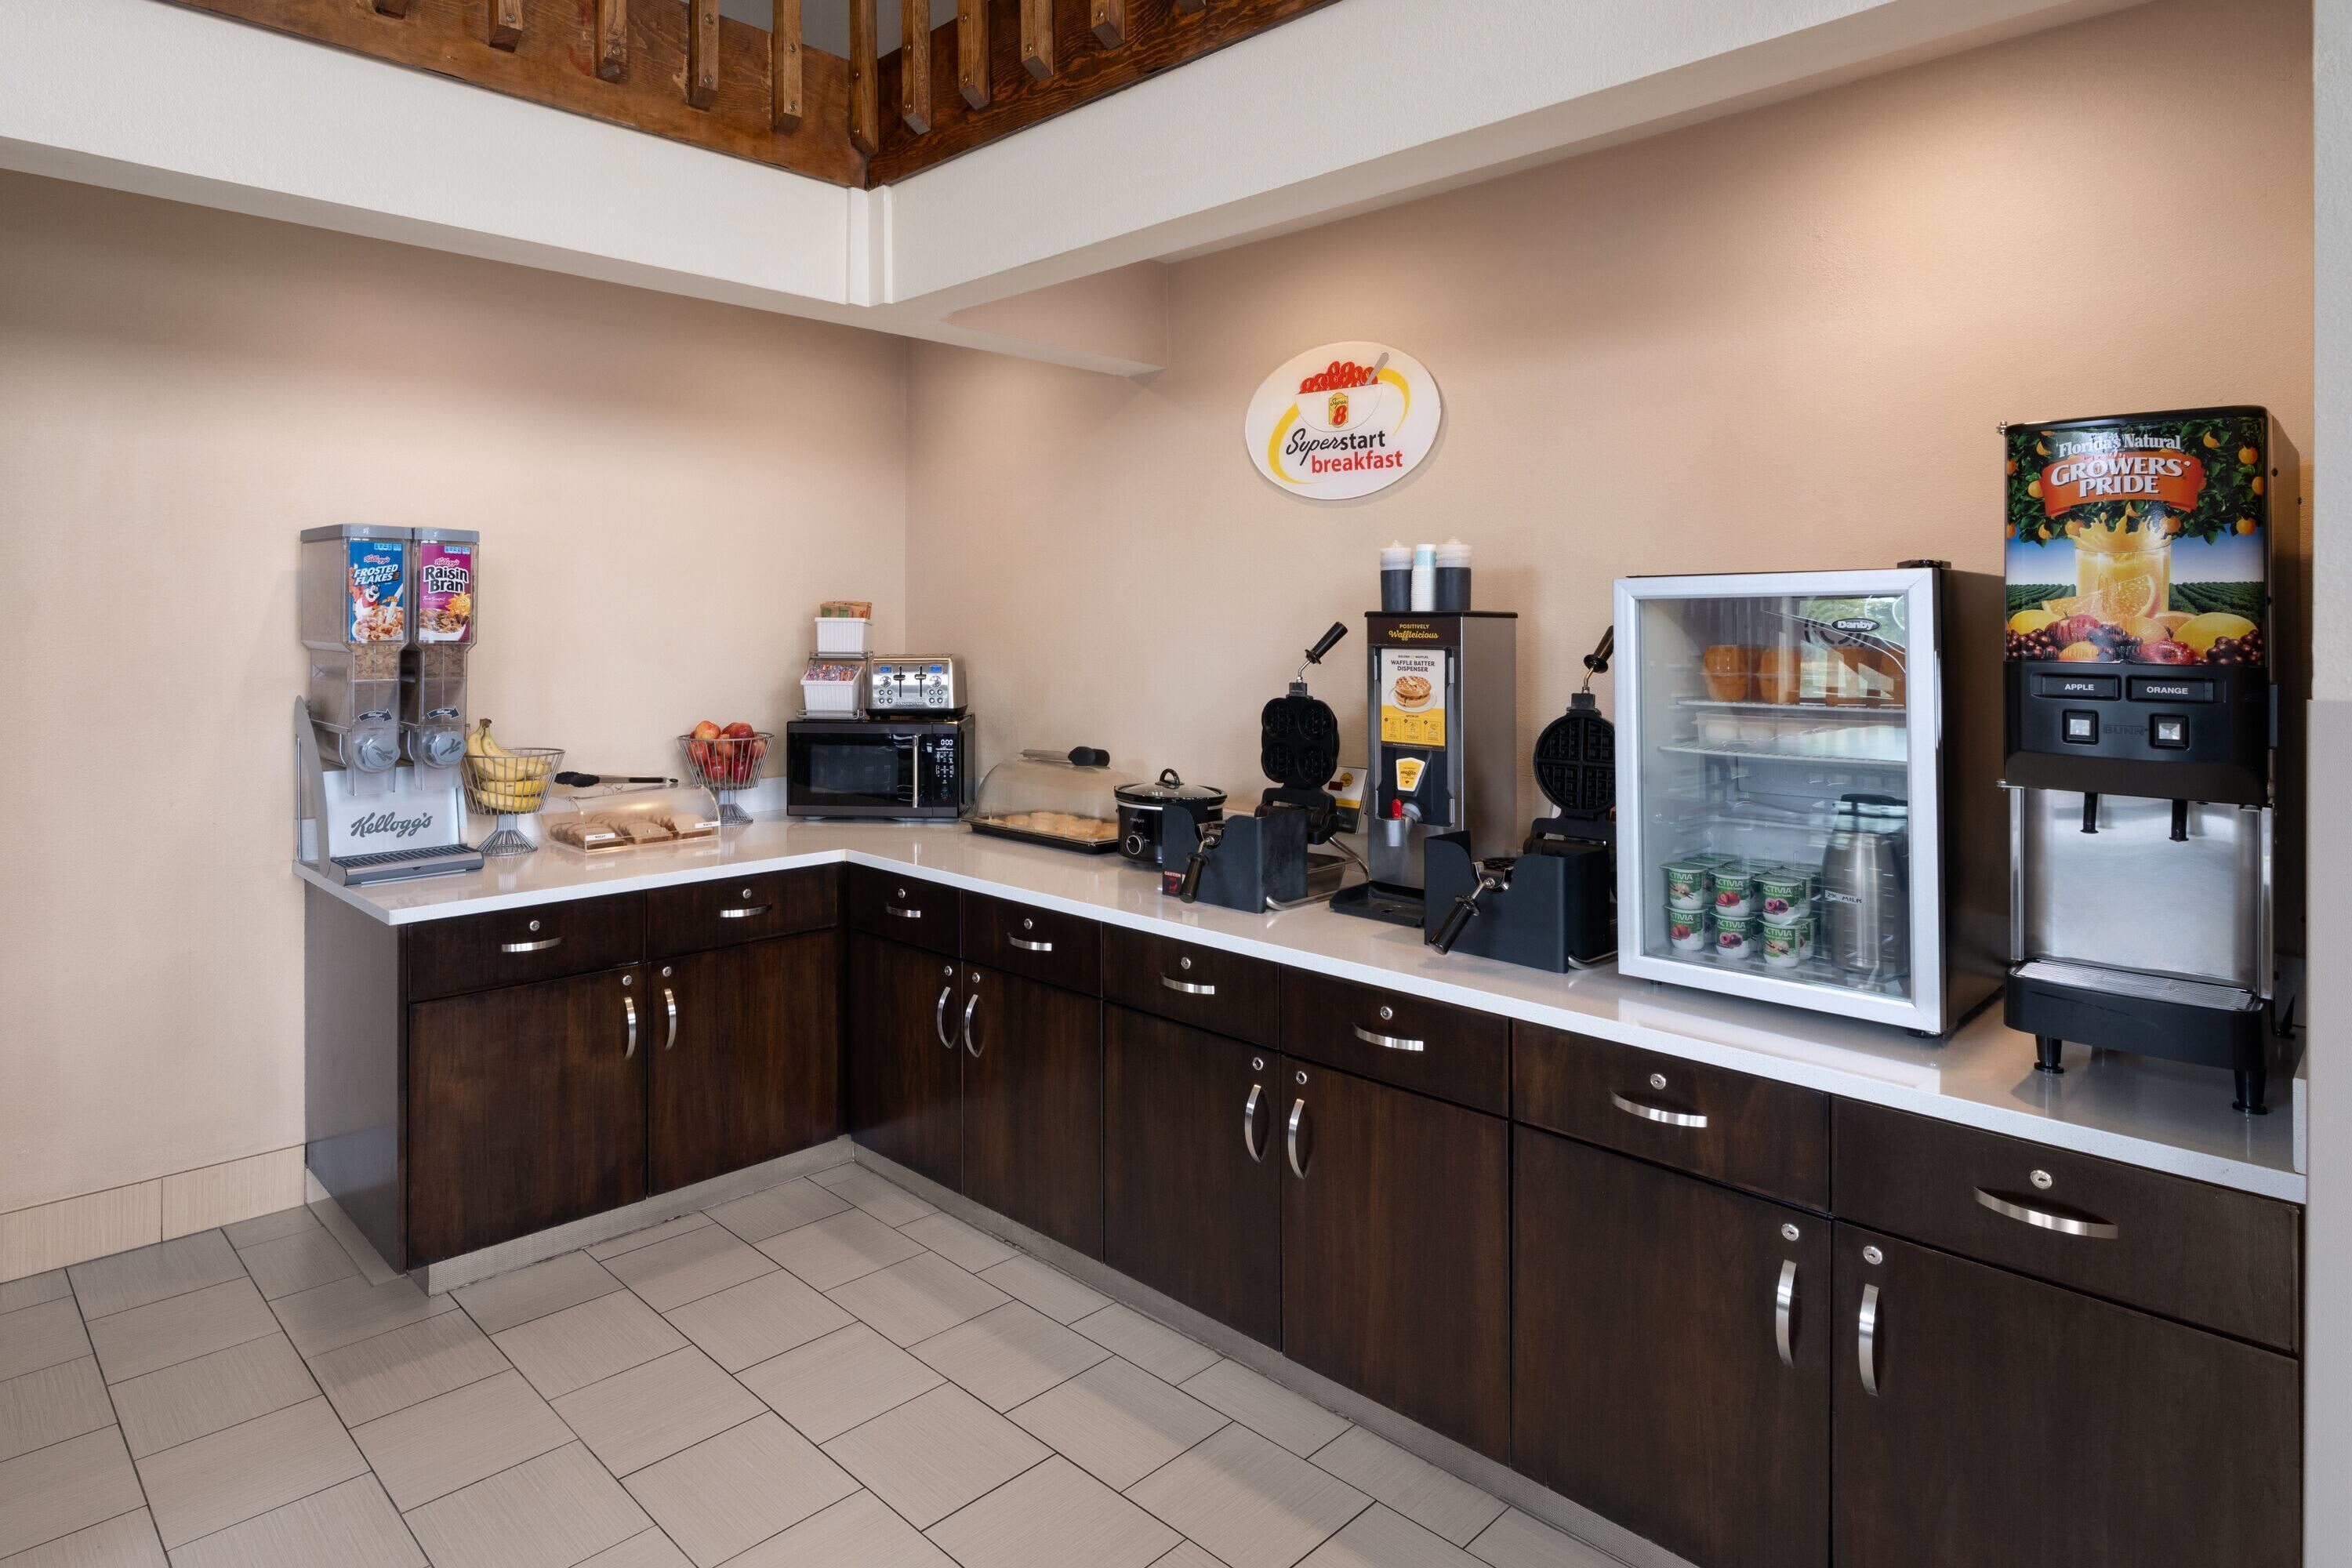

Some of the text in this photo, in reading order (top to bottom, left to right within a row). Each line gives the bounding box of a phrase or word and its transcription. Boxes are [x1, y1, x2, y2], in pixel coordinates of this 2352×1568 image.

[1330, 397, 1347, 408] Super
[1333, 405, 1347, 426] 8
[1286, 428, 1385, 466] Superstart
[2056, 434, 2181, 457] Florida's Natural
[1312, 450, 1403, 474] breakfast
[2051, 457, 2191, 486] GROWERS'
[2079, 475, 2159, 497] PRIDE
[354, 564, 398, 578] FROSTED
[424, 565, 468, 583] Raisin
[354, 572, 394, 586] FLAKES
[430, 579, 463, 593] Bran
[1838, 621, 1875, 630] Danby
[2147, 686, 2188, 695] ORANGE
[2103, 724, 2144, 735] BUNN
[350, 811, 433, 838] Kellogg's
[1669, 872, 1693, 880] CTIVIA
[1715, 878, 1744, 887] ACTIVIA
[1762, 884, 1792, 894] ACTIVIA
[1670, 912, 1693, 921] CTIVIA
[1717, 919, 1746, 928] ACTIVIA
[1764, 926, 1792, 937] ACTIVIA
